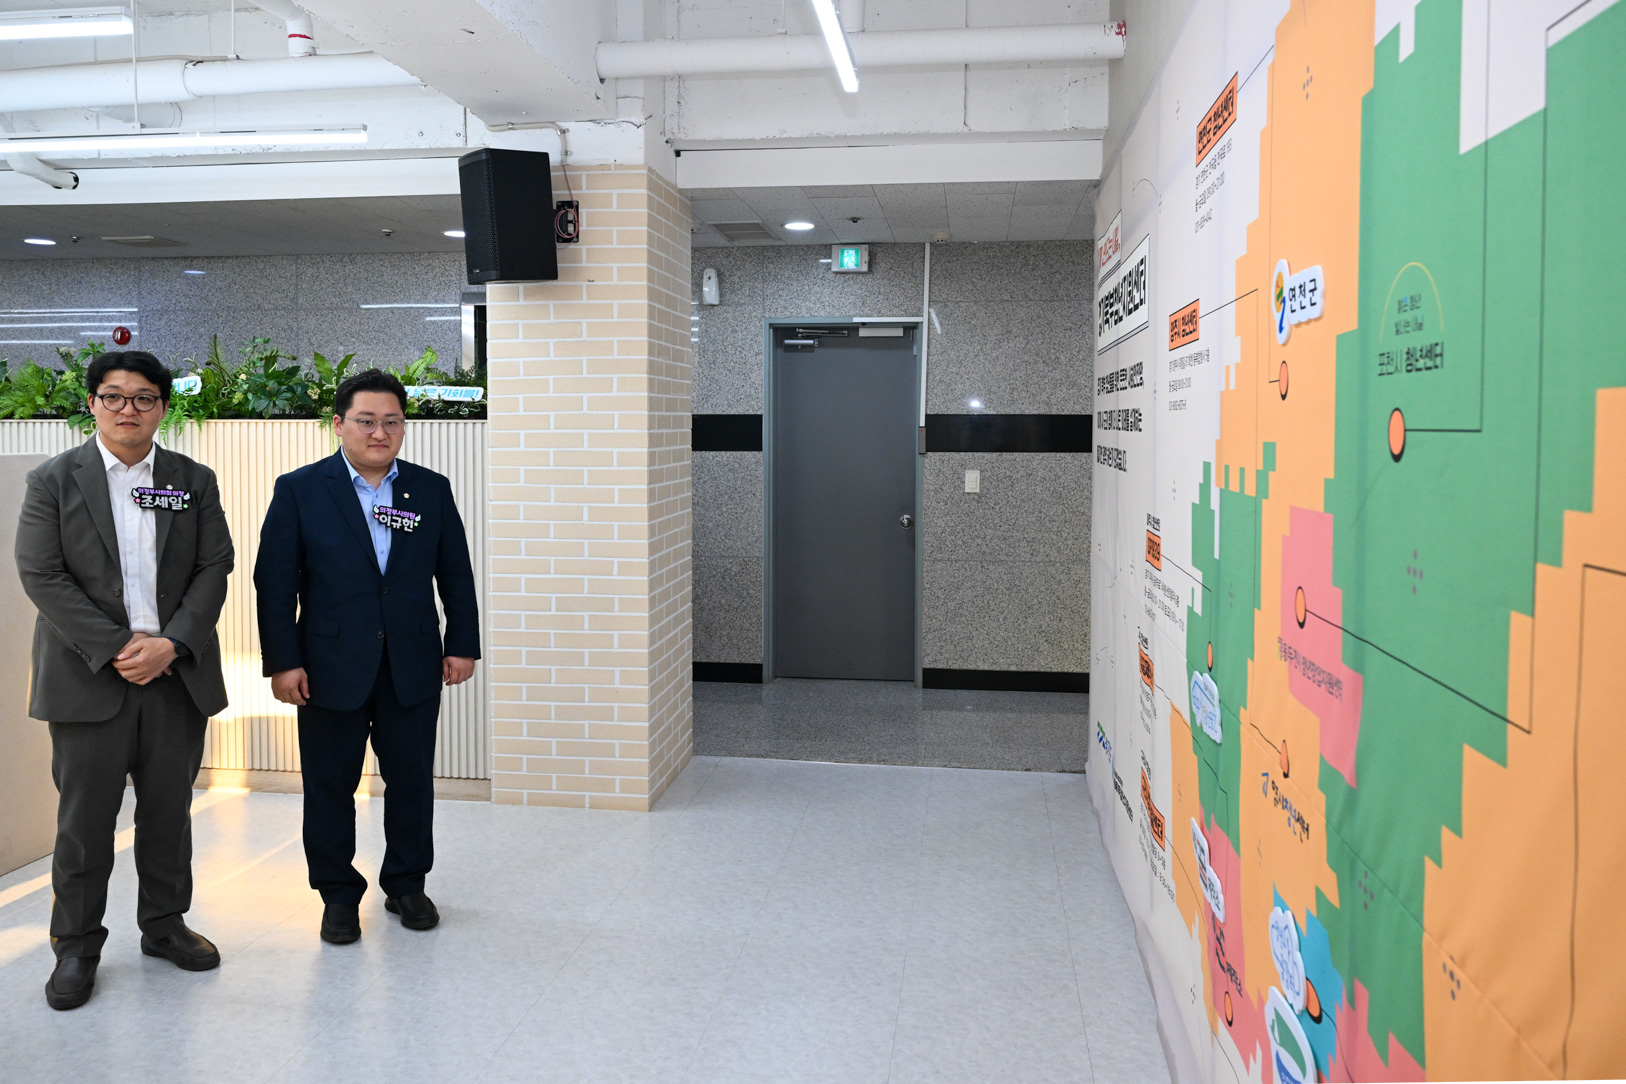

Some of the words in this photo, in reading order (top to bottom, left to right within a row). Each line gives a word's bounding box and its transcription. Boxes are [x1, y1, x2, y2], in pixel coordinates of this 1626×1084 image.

[1288, 278, 1318, 314] 연천군
[1378, 350, 1403, 377] 포천시
[1405, 341, 1444, 374] 청년센터
[440, 388, 480, 399] 기회를!
[138, 488, 173, 497] 의정부시의회
[141, 495, 184, 511] 조세일
[379, 507, 416, 520] 의정부시의원
[379, 514, 415, 533] 이규헌
